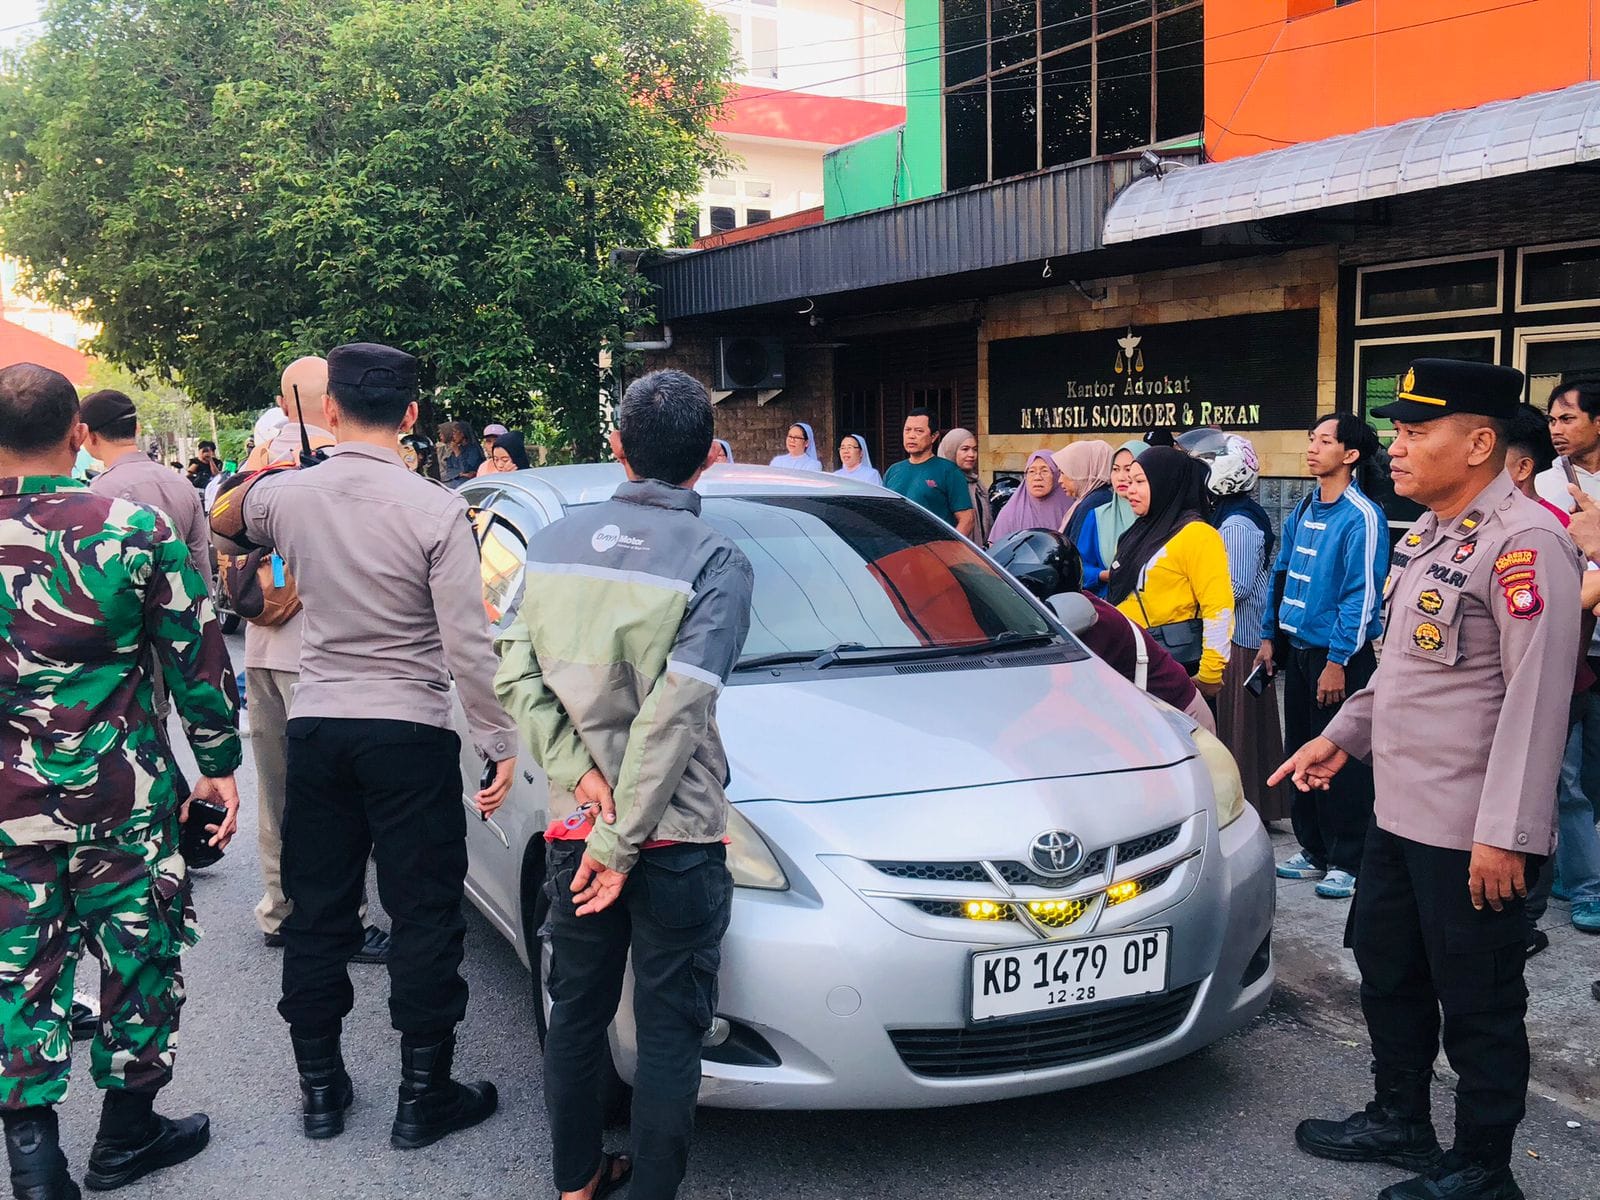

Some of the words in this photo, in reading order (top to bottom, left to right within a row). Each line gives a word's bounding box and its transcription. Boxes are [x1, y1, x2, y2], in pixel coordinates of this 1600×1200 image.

[1067, 381, 1115, 398] Kantor
[1123, 375, 1191, 396] Advokat
[1021, 406, 1088, 429] M.TAMSIL
[1092, 403, 1176, 427] SJOEKOER
[1182, 402, 1194, 426] &
[1426, 562, 1468, 588] POLRI
[983, 957, 1021, 995] KB
[1033, 944, 1107, 989] 1479
[1123, 936, 1159, 975] OP
